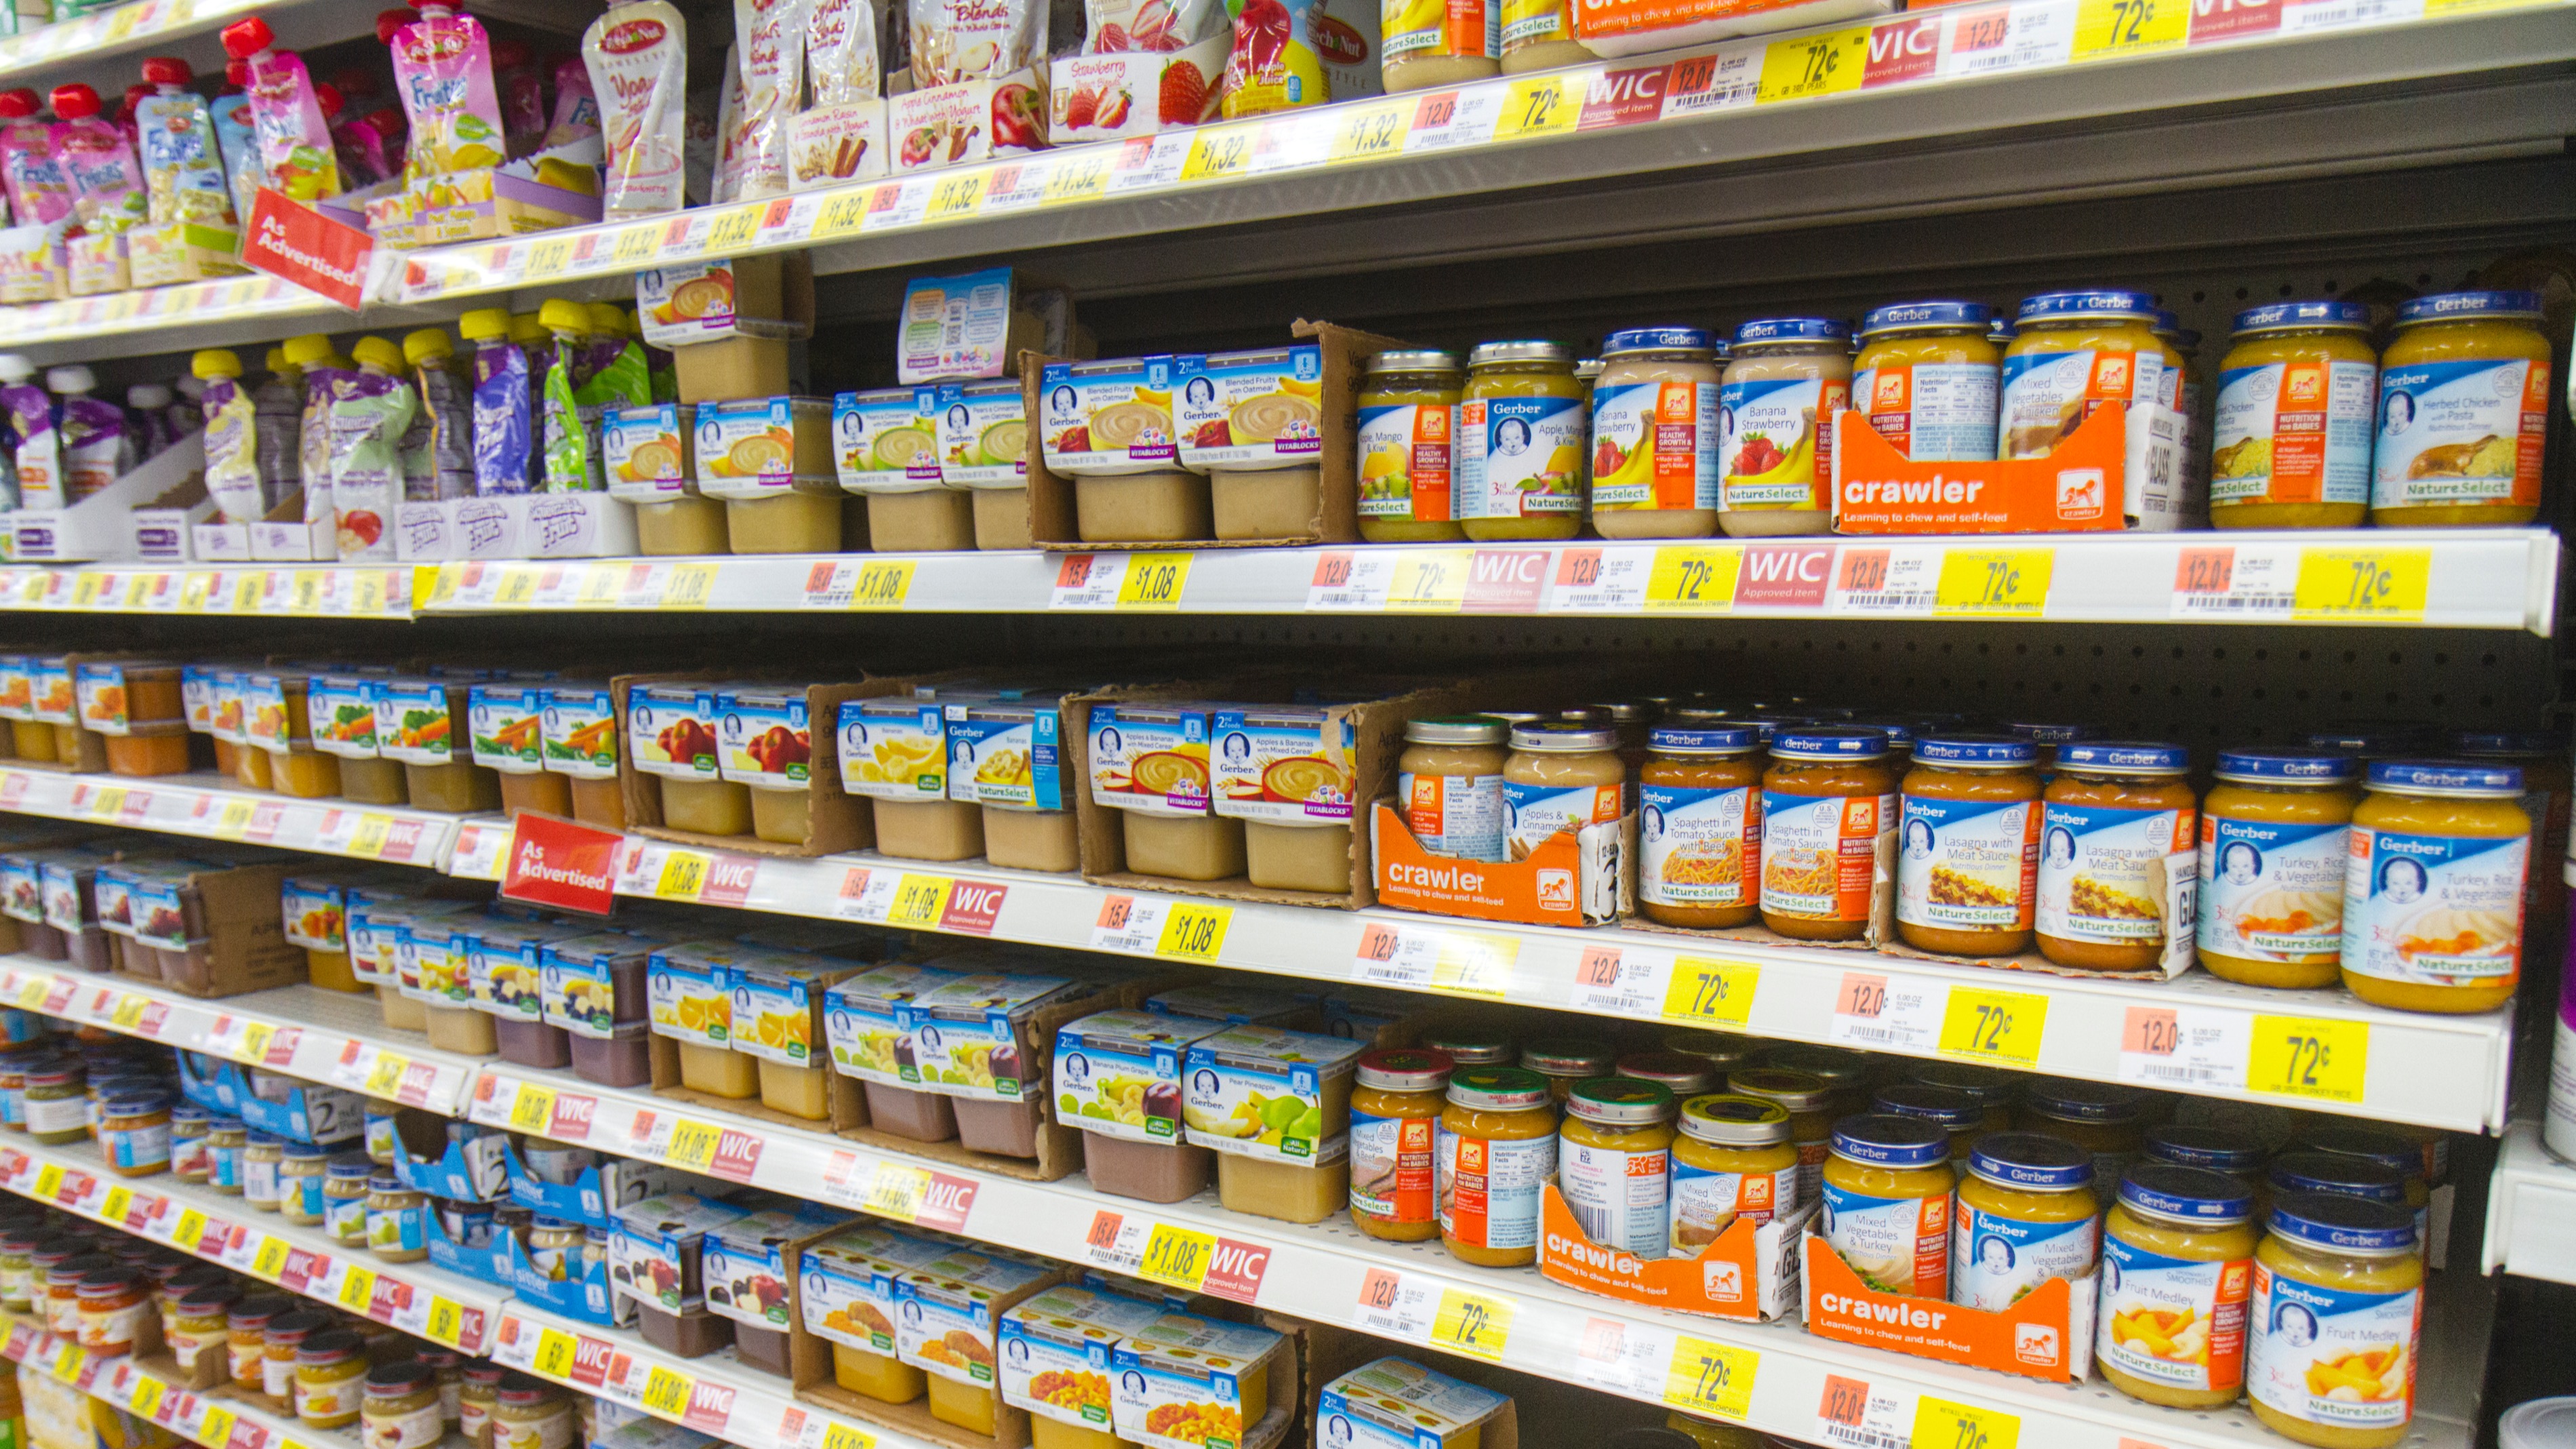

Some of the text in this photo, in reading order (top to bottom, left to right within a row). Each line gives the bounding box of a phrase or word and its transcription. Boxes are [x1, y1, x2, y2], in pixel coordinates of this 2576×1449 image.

[957, 5, 1009, 21] Blends
[1587, 18, 1628, 31] Learning
[1632, 14, 1641, 22] to
[1645, 9, 1670, 20] chew
[1673, 6, 1691, 15] and
[1071, 60, 1125, 78] Strawberry
[1257, 62, 1285, 73] Apple
[1803, 45, 1839, 83] 72¢
[1258, 75, 1284, 85] Juice
[1589, 71, 1662, 105] WIC
[902, 87, 969, 108] Apple Cinnamon
[1523, 90, 1559, 127] 72¢
[1583, 102, 1653, 121] Approved item
[1351, 114, 1398, 151] $1.32
[1201, 134, 1245, 172] $1.32
[941, 180, 977, 212] $1.32
[828, 193, 856, 227] $1.32
[259, 214, 286, 237] As
[256, 232, 358, 285] Advertised
[2434, 298, 2487, 313] Gerber
[1659, 334, 1696, 345] Gerber
[1740, 326, 1773, 338] Gerber
[1225, 375, 1276, 386] Blended Fruits
[2020, 377, 2051, 391] Mixed
[2383, 373, 2430, 386] Gerber
[1243, 384, 1274, 393] Oatmeal
[2011, 391, 2064, 407] Vegetables
[1183, 410, 1220, 420] Gerber
[1493, 404, 1540, 414] Gerber
[1601, 411, 1627, 421] Banana
[1750, 407, 1786, 417] Banana
[1049, 416, 1081, 427] Gerber
[1742, 418, 1796, 431] Strawberry
[1276, 441, 1318, 452] VITABLOCKS
[1845, 473, 1984, 504] crawler
[2407, 481, 2507, 496] NatureSelect
[1844, 511, 2007, 526] Learning to chew and self-feed
[1477, 555, 1542, 583] WIC
[1750, 552, 1826, 583] WIC
[860, 570, 899, 599] $1.08
[1136, 564, 1177, 600] $1.08
[1413, 563, 1445, 599] 72¢
[1677, 561, 1712, 599] 72¢
[1986, 561, 2019, 601] 72¢
[2350, 561, 2392, 604] 72¢
[1742, 588, 1818, 599] Approved item
[948, 726, 984, 738] Gerber
[1666, 734, 1703, 745] Gerber
[1256, 738, 1277, 747] Apples
[1097, 757, 1125, 767] Gerber
[1220, 763, 1253, 774] Gerber
[978, 786, 1030, 799] NatureSelect
[1642, 789, 1673, 803] Gerber
[1525, 808, 1563, 820] Apples &
[1906, 802, 1946, 818] Gerber
[2047, 810, 2089, 826] Gerber
[1522, 819, 1566, 831] Cinnamon
[1674, 818, 1731, 830] Spaghetti in
[1771, 823, 1822, 839] Spaghetti in
[2221, 821, 2278, 841] Gerber
[1670, 829, 1735, 840] Tomato Sauce
[1769, 835, 1828, 850] Tomato Sauce
[1944, 835, 2013, 850] Lasagna with
[1679, 841, 1725, 851] with Beef
[1947, 849, 2009, 861] Meat Sauce
[2278, 856, 2344, 870] Turkey, Rice
[517, 839, 607, 892] As Advertised
[712, 862, 755, 889] WIC
[1388, 862, 1485, 892] crawler
[2273, 869, 2346, 884] & Vegetables
[906, 883, 935, 920] $1.08
[954, 886, 1003, 916] WIC
[1388, 884, 1420, 897] Learning
[1432, 891, 1452, 900] chew
[1454, 894, 1470, 902] and
[1472, 896, 1504, 906] self-feed
[1927, 907, 2011, 921] NatureSelect
[1175, 913, 1217, 953] $1.08
[2417, 957, 2510, 972] NatureSelect
[1693, 972, 1730, 1016] 72¢
[1975, 1004, 2013, 1051] 72¢
[1092, 1060, 1149, 1075] Banana Plum Grape
[2285, 1037, 2330, 1086] 72¢
[1063, 1080, 1092, 1092] Gerber
[557, 1096, 595, 1122] WIC
[1190, 1096, 1222, 1109] Gerber
[719, 1136, 756, 1164] WIC
[1849, 1143, 1887, 1159] Gerber
[925, 1184, 974, 1213] WIC
[1678, 1193, 1718, 1211] Vegetables
[1855, 1214, 1887, 1228] Mixed
[1978, 1218, 2028, 1237] Gerber
[1845, 1223, 1898, 1241] Vegetables
[1151, 1239, 1199, 1275] $1.08
[1209, 1244, 1266, 1279] WIC
[1547, 1233, 1643, 1277] crawler
[1204, 1274, 1254, 1294] Approved item
[2125, 1279, 2195, 1307] Fruit Medley
[2276, 1280, 2335, 1307] Gerber
[1820, 1292, 1946, 1331] crawler
[577, 1340, 609, 1369] WIC
[2112, 1346, 2197, 1378] NatureSelect
[1695, 1356, 1731, 1403] 72¢
[695, 1385, 731, 1414] WIC
[1120, 1395, 1148, 1408] Gerber
[1703, 1401, 1714, 1410] VEG
[1715, 1404, 1741, 1416] CHICKEN
